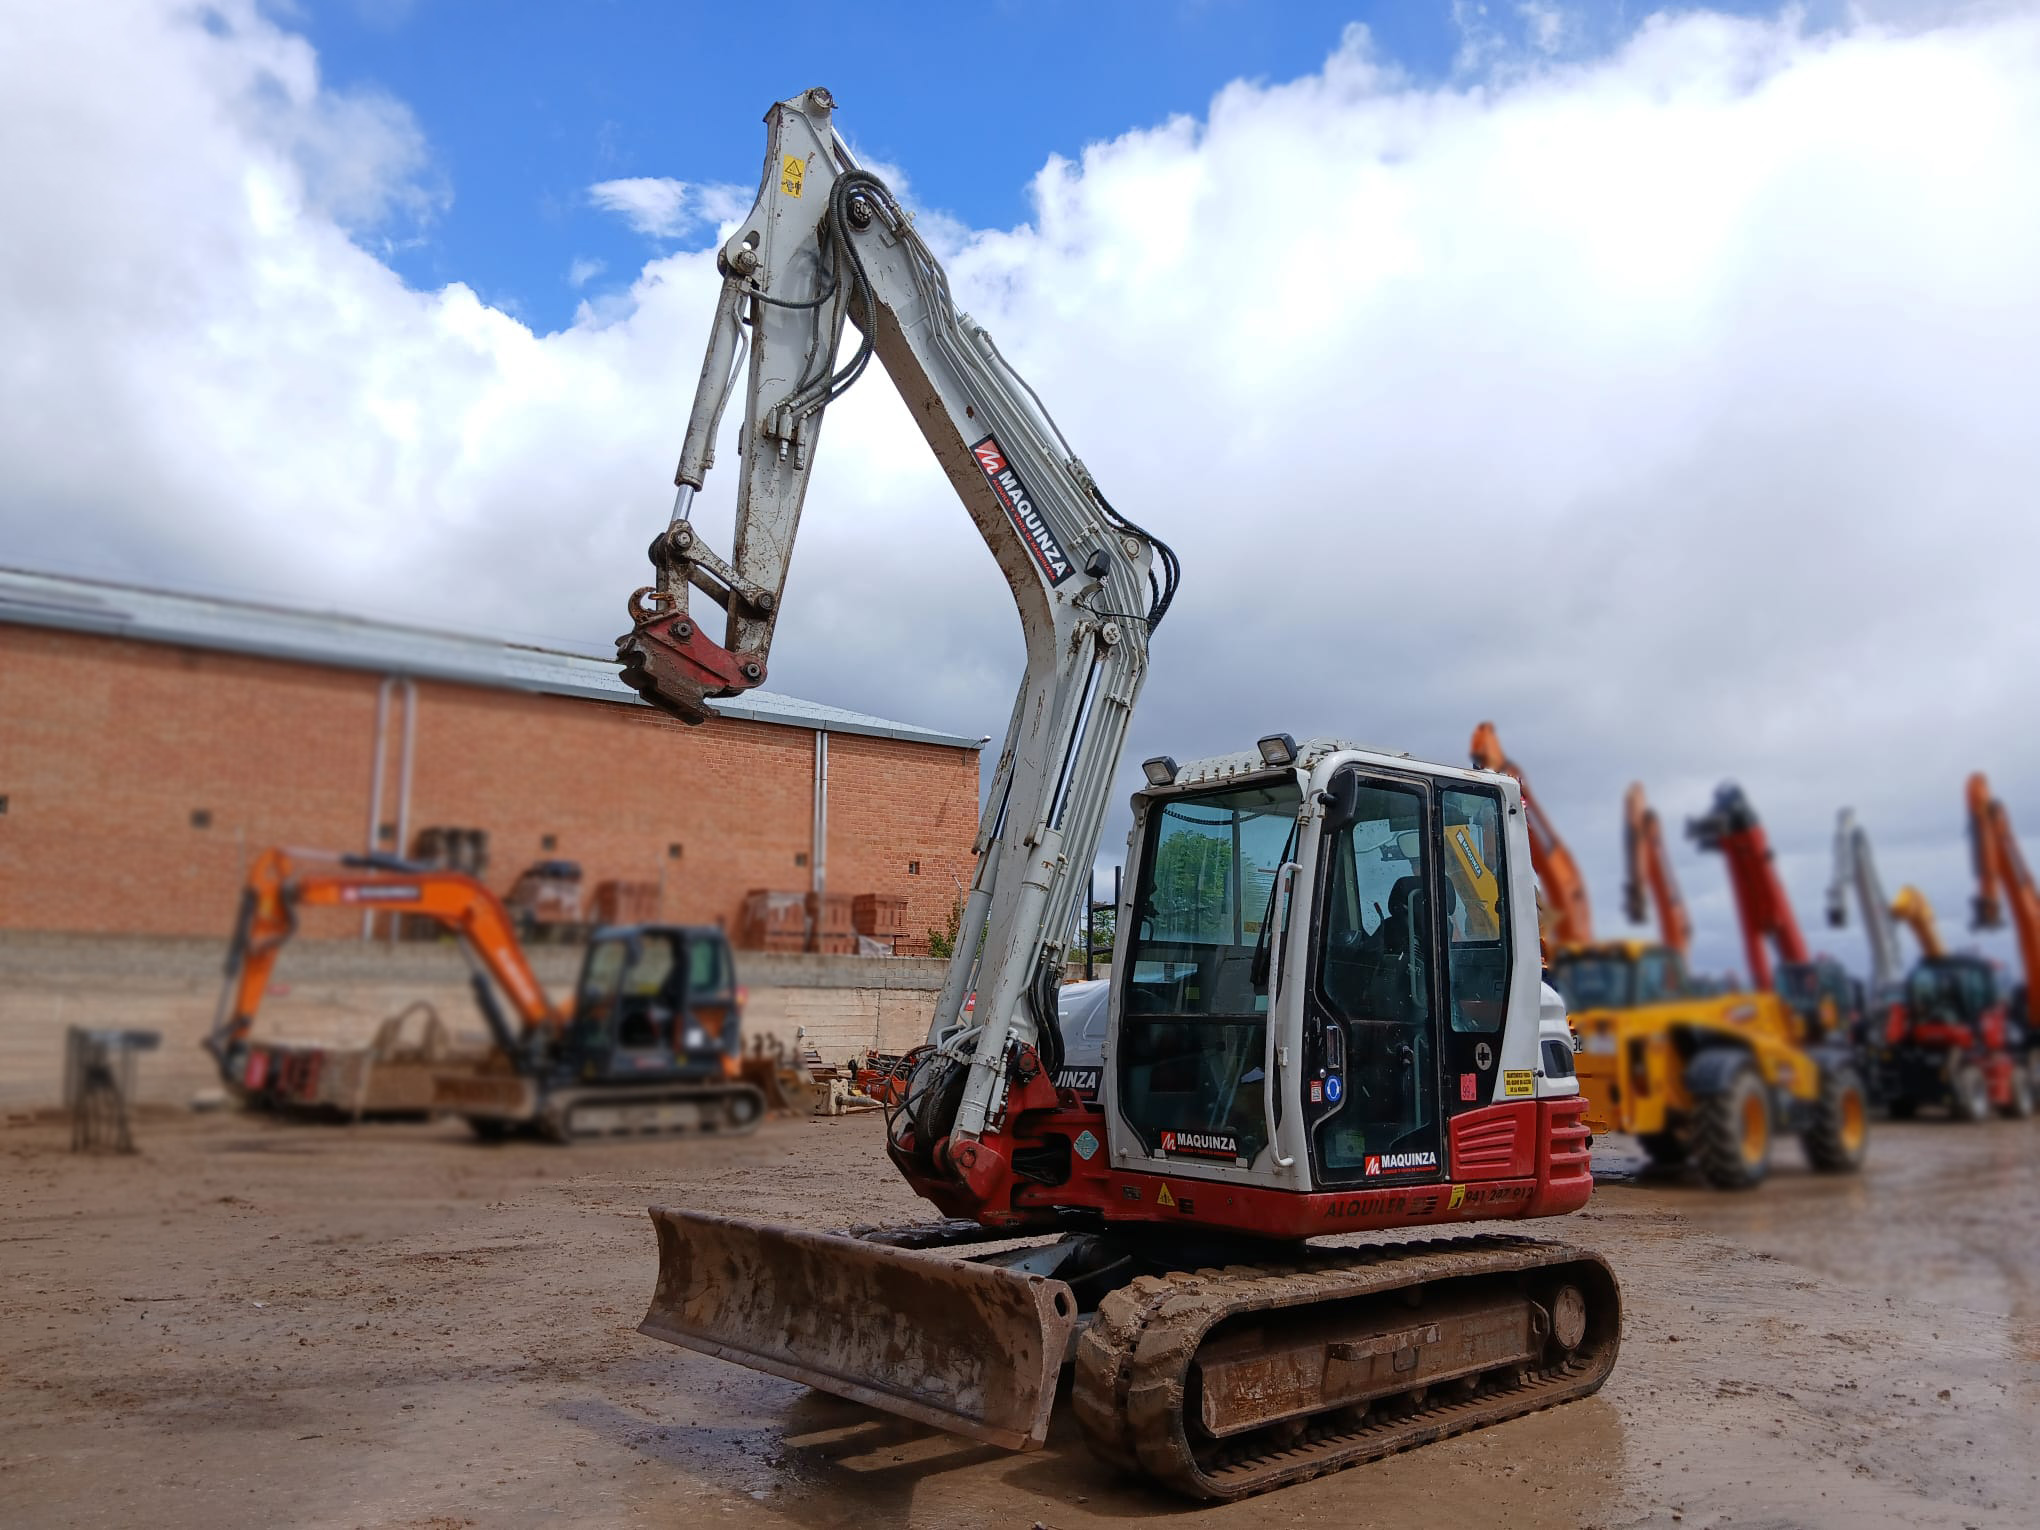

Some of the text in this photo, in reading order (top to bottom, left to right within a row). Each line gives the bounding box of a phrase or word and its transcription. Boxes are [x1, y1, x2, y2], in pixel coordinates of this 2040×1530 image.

[998, 470, 1067, 577] MAQUINZA
[1177, 1132, 1237, 1151] MAQUINZA
[1381, 1151, 1436, 1168] MAQUINZA
[1324, 1197, 1407, 1218] ALQUILER
